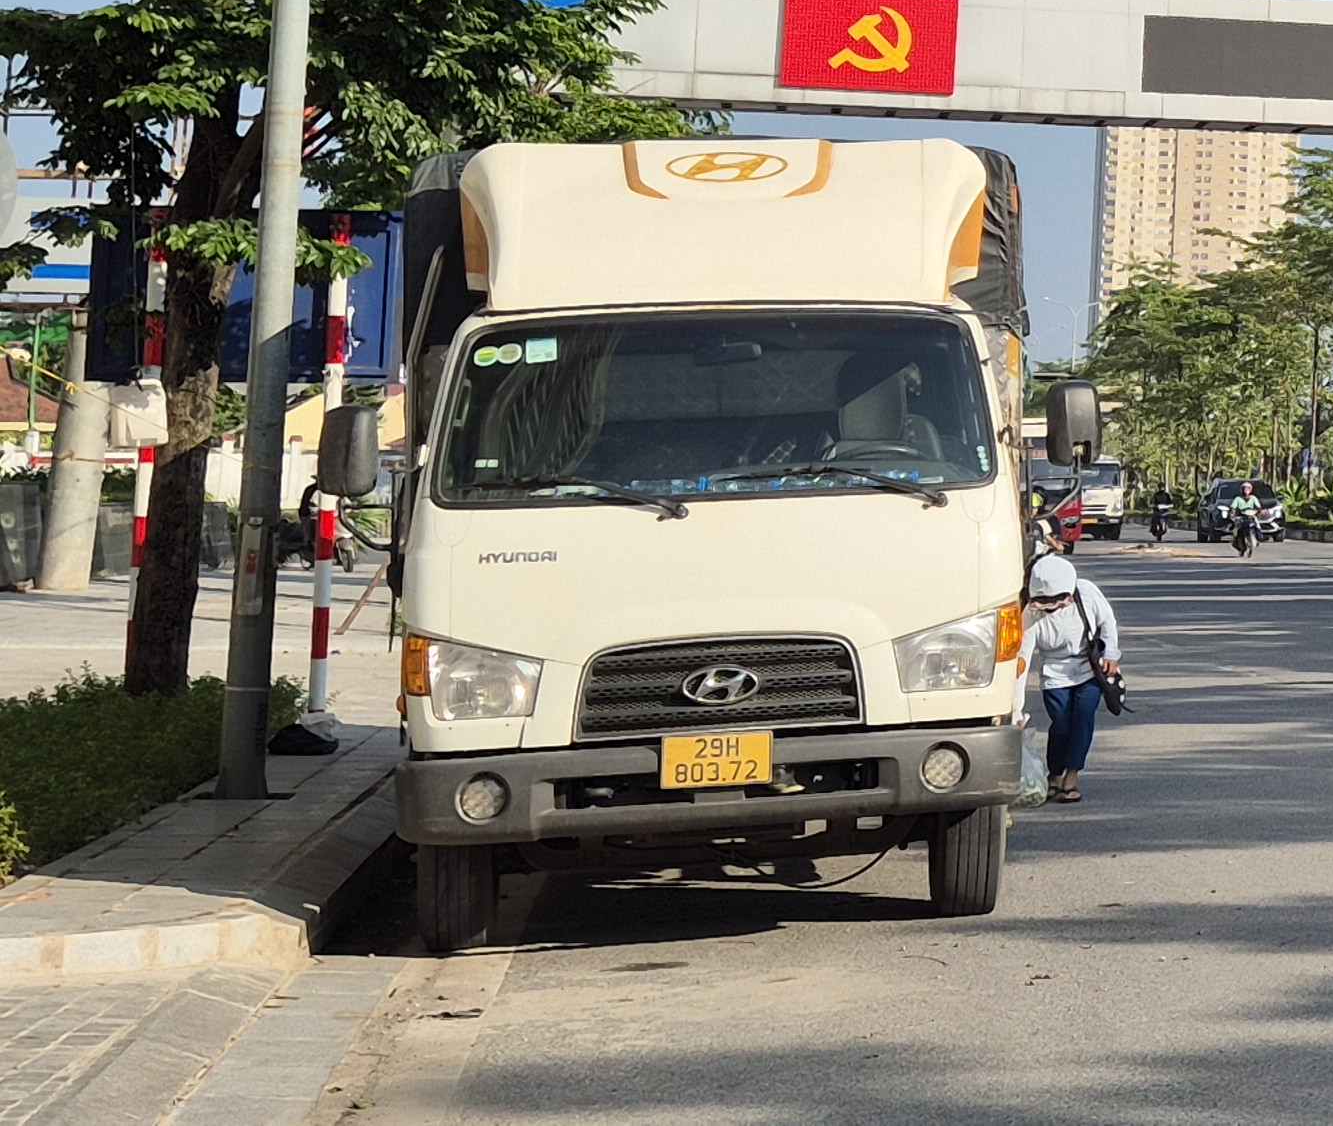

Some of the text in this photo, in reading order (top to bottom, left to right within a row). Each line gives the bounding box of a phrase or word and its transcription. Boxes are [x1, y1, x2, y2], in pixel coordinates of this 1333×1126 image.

[478, 550, 557, 564] HYUNDAI
[694, 736, 740, 759] 29H
[674, 759, 758, 784] 803.72
